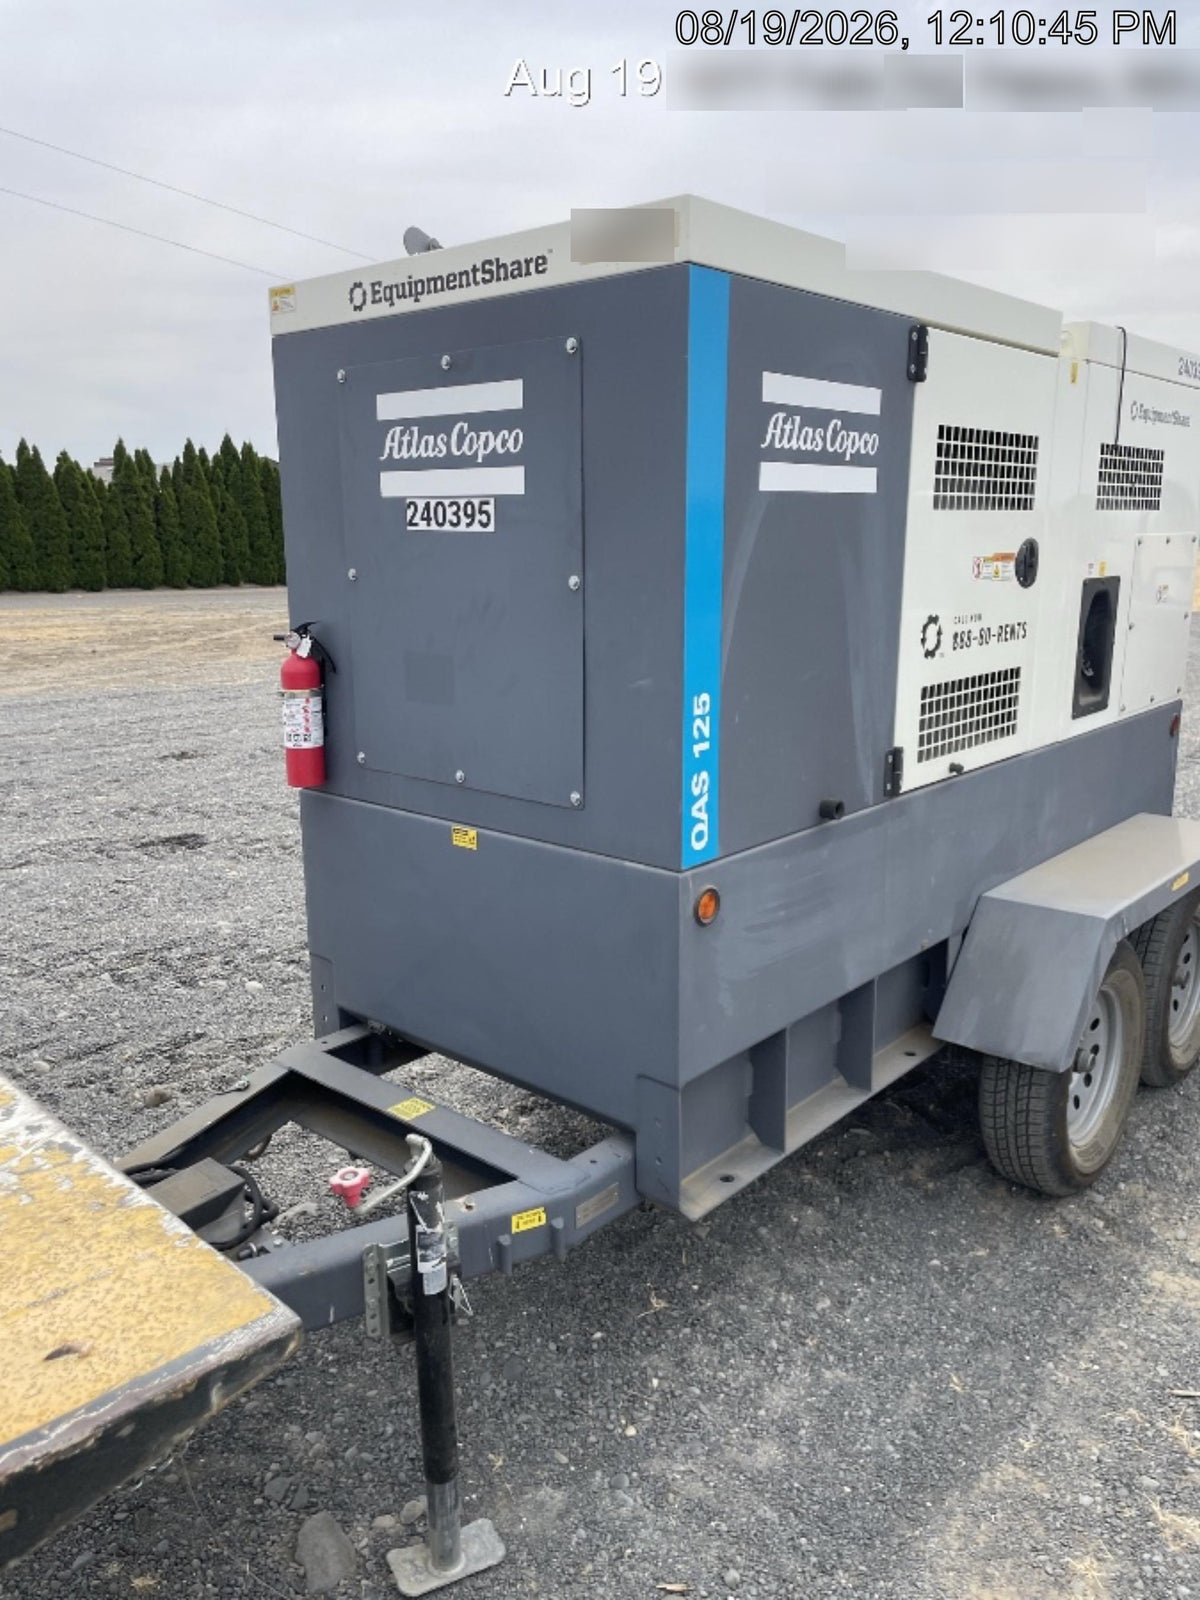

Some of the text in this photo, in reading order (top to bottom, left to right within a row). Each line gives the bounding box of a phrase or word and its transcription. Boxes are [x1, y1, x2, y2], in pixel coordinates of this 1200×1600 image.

[371, 254, 548, 307] EquipmentShare
[379, 421, 524, 463] Atlas Copco
[760, 411, 879, 461] Atlas Copco
[406, 500, 493, 529] 240395
[692, 692, 711, 758] 125
